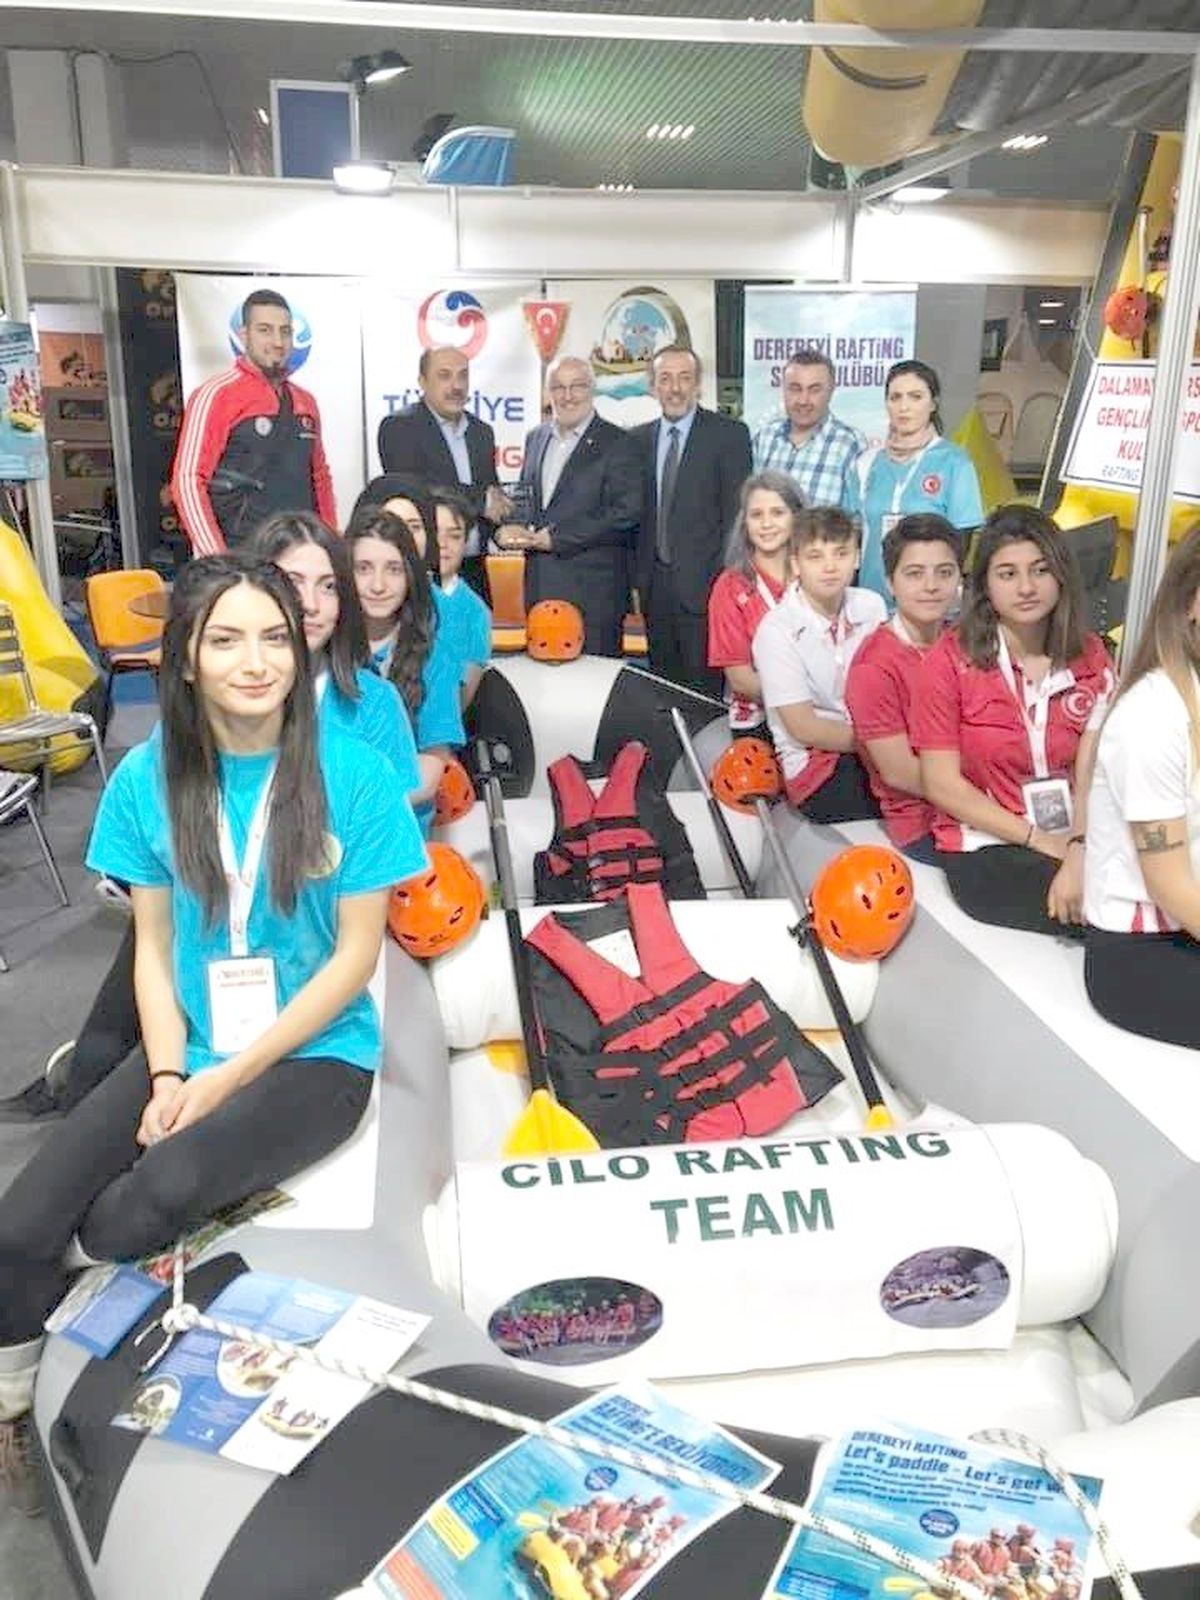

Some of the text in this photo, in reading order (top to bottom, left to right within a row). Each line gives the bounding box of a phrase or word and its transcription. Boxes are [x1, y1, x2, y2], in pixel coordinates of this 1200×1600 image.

[834, 361, 885, 387] ULÜBÜ
[382, 389, 524, 421] TİYE
[501, 1131, 952, 1189] CİLO RAFTING
[650, 1188, 835, 1244] TEAM
[844, 1443, 887, 1464] Let's
[887, 1454, 950, 1473] paddle
[964, 1465, 1007, 1485] Let's
[1010, 1477, 1044, 1491] get
